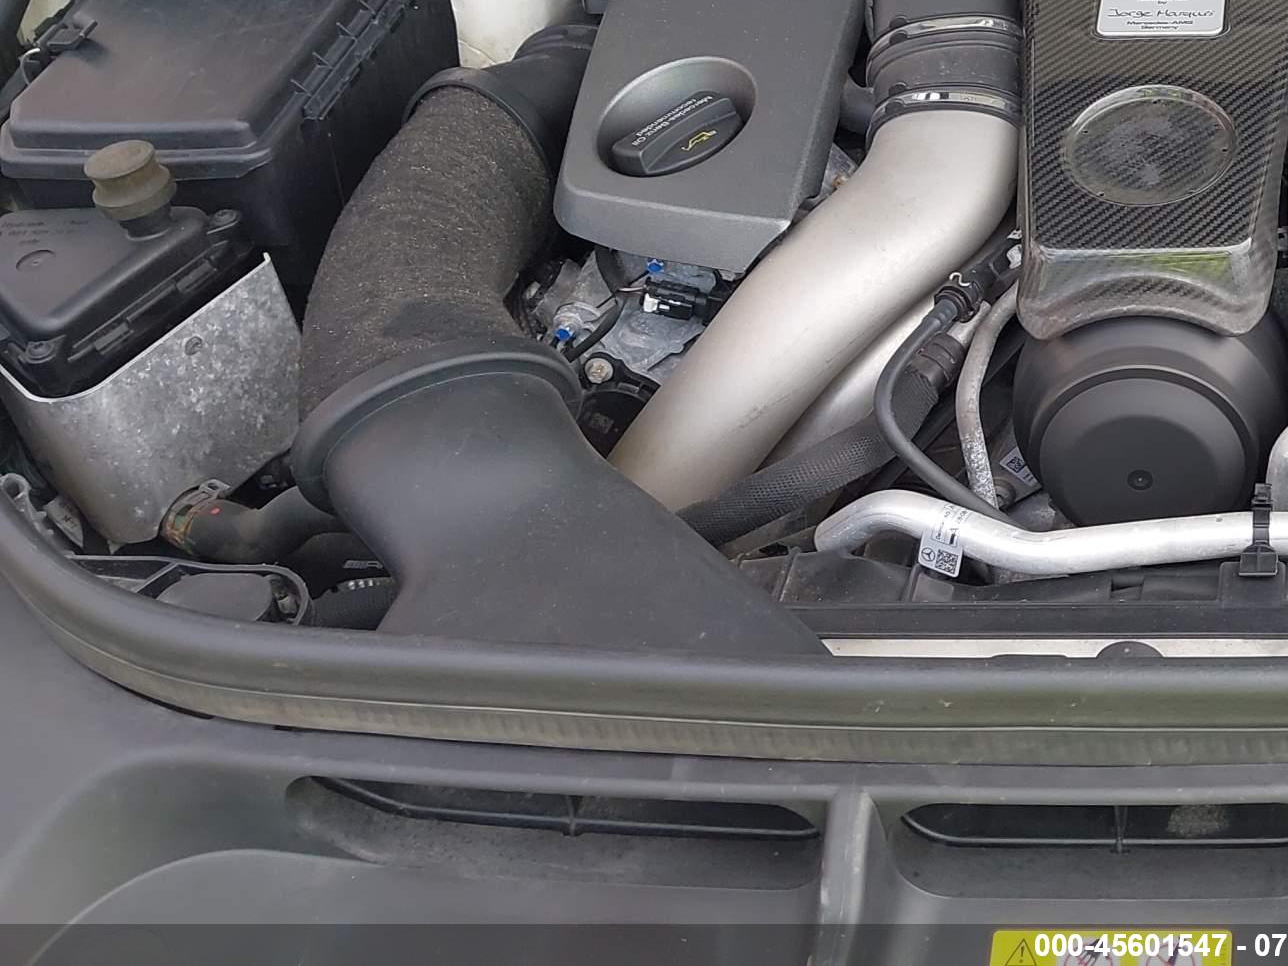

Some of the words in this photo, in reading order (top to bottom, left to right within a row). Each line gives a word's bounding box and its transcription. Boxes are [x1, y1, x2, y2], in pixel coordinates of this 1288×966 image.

[635, 97, 698, 137] recommended
[646, 95, 714, 137] Mercedes-Benz
[631, 135, 647, 147] Oil
